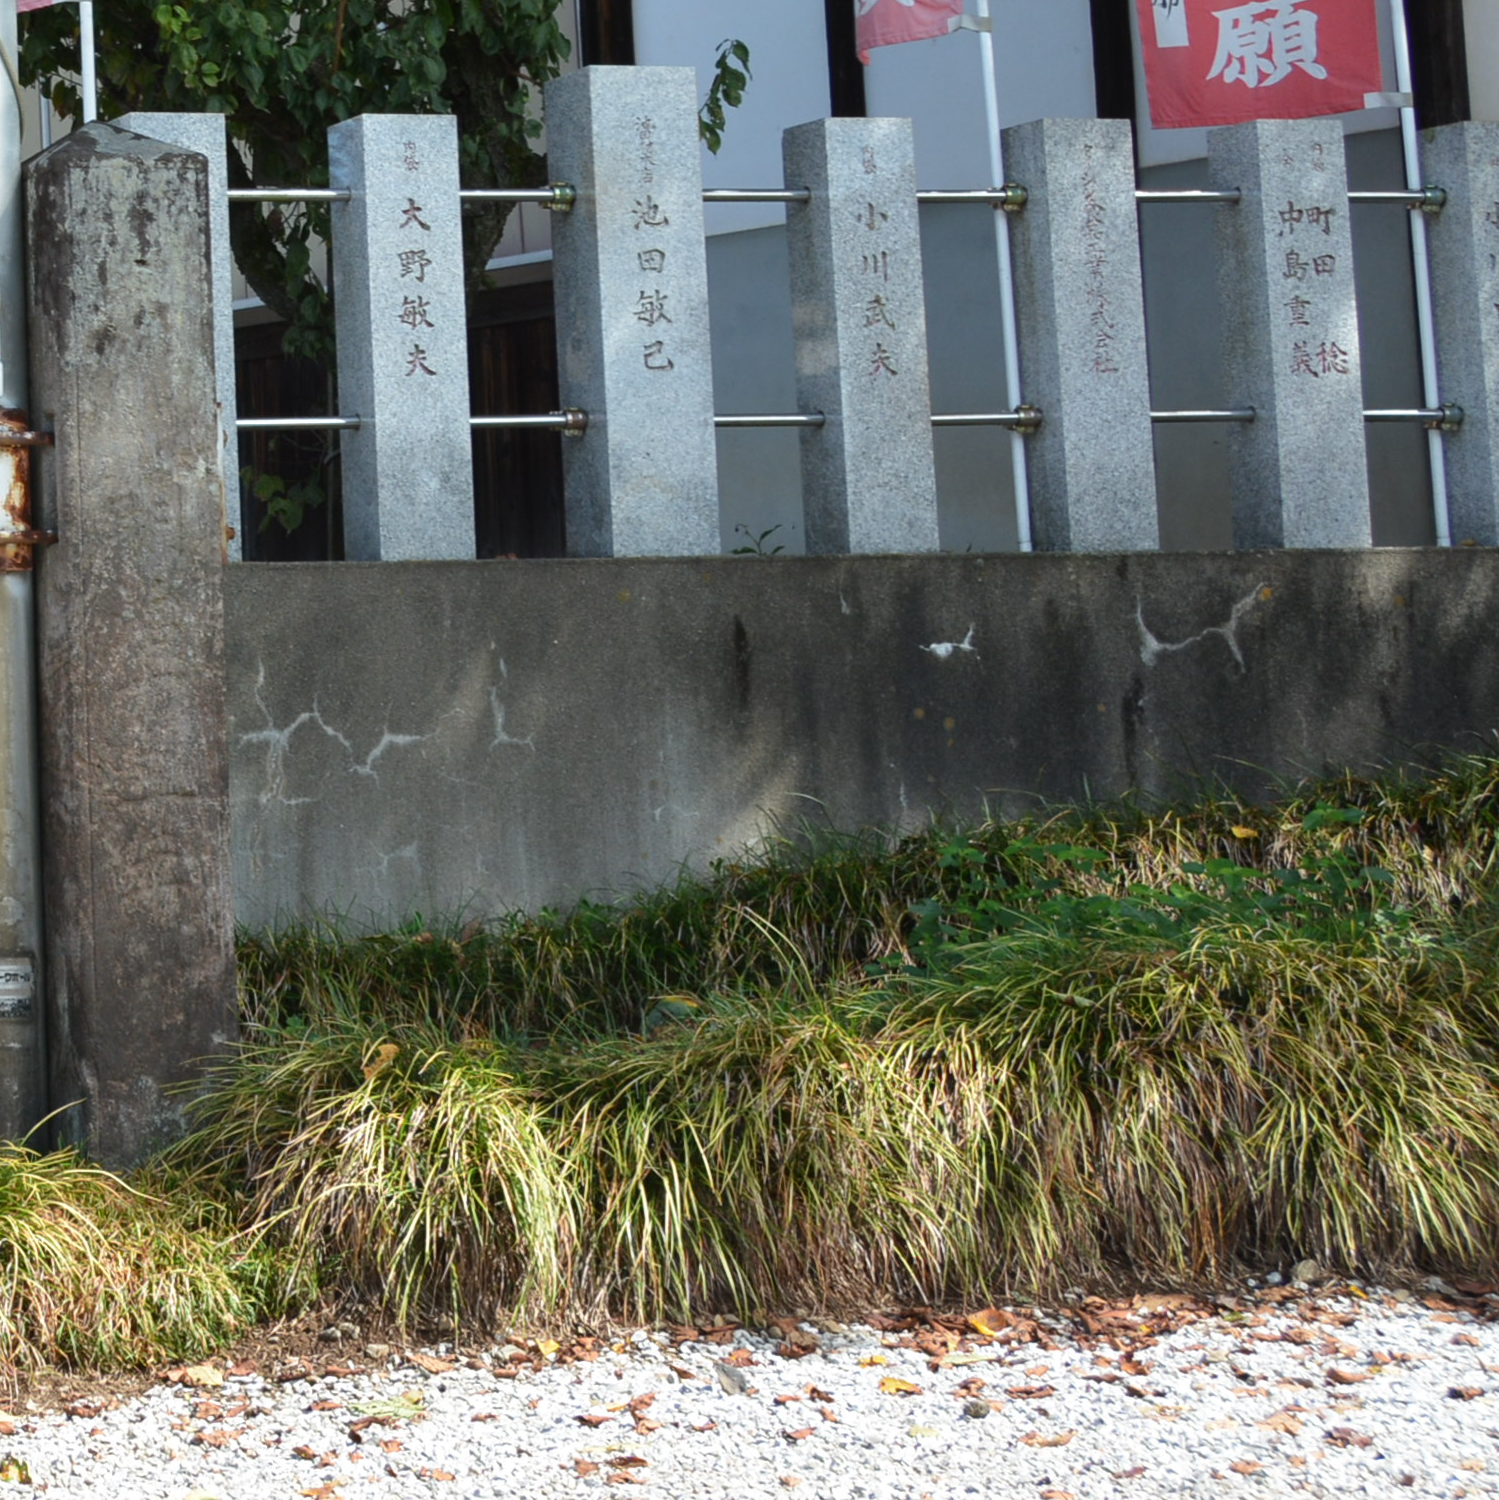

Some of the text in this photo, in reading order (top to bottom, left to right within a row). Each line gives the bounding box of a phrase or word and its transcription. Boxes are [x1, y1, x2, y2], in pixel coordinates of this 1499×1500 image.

[398, 197, 437, 378] 大野敏夫
[631, 194, 675, 371] 池田敏己
[857, 201, 899, 376] 小川武夫
[1278, 200, 1319, 379] 中島重義
